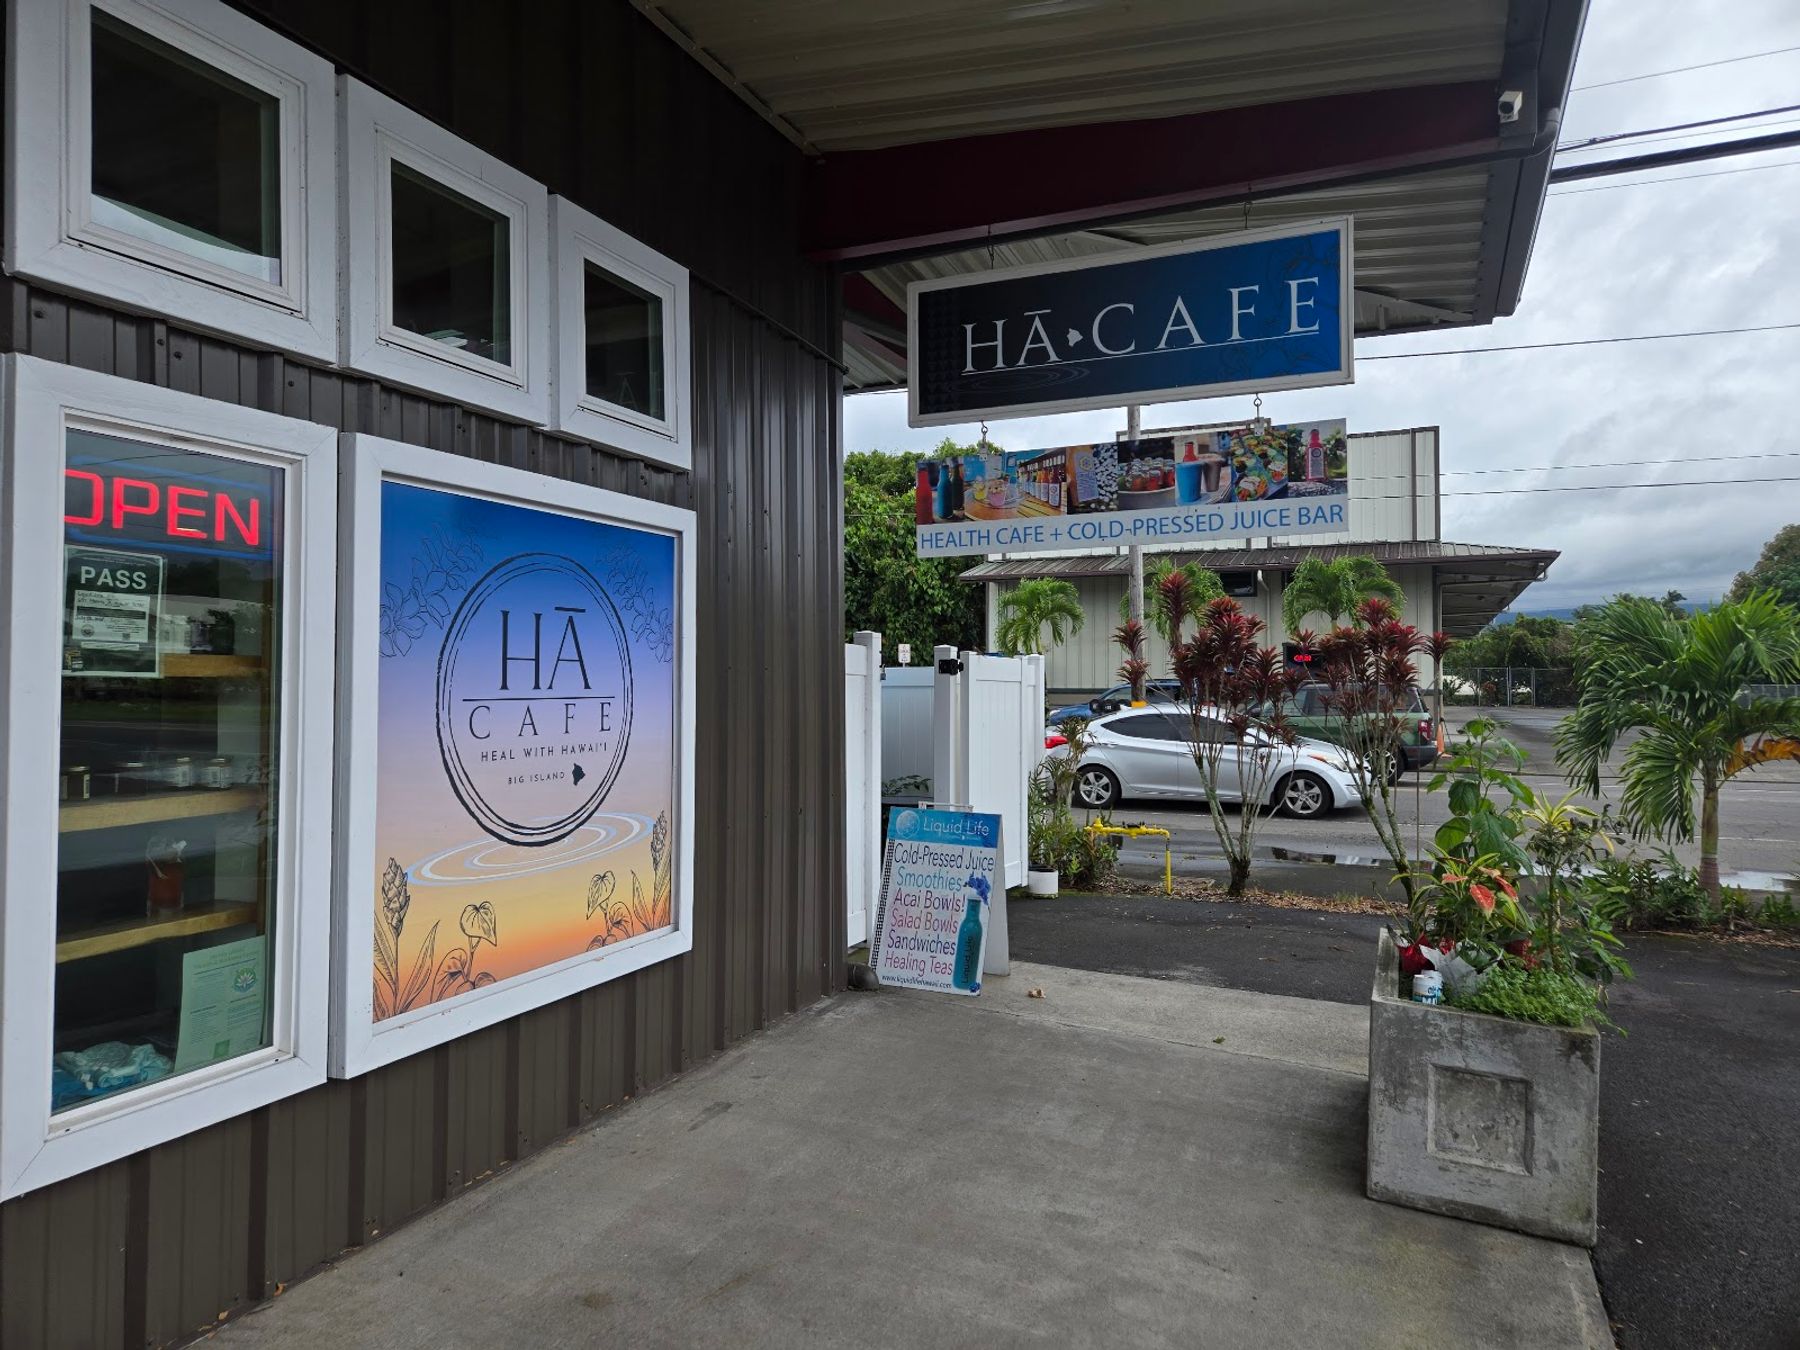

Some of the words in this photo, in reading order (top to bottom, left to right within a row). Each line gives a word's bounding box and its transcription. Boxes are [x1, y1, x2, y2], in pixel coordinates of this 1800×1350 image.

[1092, 276, 1320, 356] CAFE
[63, 468, 260, 546] OPEN
[921, 528, 990, 549] HEALTH
[996, 525, 1044, 545] CAFE
[1050, 528, 1063, 542] +
[1069, 512, 1224, 541] COLD-PRESSED
[1230, 508, 1291, 531] JUICE
[1298, 504, 1344, 526] BAR
[80, 565, 147, 590] PASS
[499, 606, 592, 690] HĀ
[469, 701, 612, 740] CAFE
[481, 750, 516, 762] HEAL
[523, 745, 554, 757] WITH
[508, 775, 524, 785] BIG
[530, 771, 565, 783] ISLAND
[923, 818, 963, 837] Liquid
[966, 820, 989, 836] Life
[894, 842, 964, 869] Cold-Pressed
[965, 850, 995, 872] Juice
[896, 866, 962, 892] Smoothies
[893, 887, 921, 908] Acai
[923, 889, 966, 912] Bowls!
[890, 907, 922, 930] Salad
[924, 911, 958, 935] Bowls
[887, 929, 957, 956] Sandwiches
[884, 950, 926, 977] Healing
[929, 955, 953, 976] Teas
